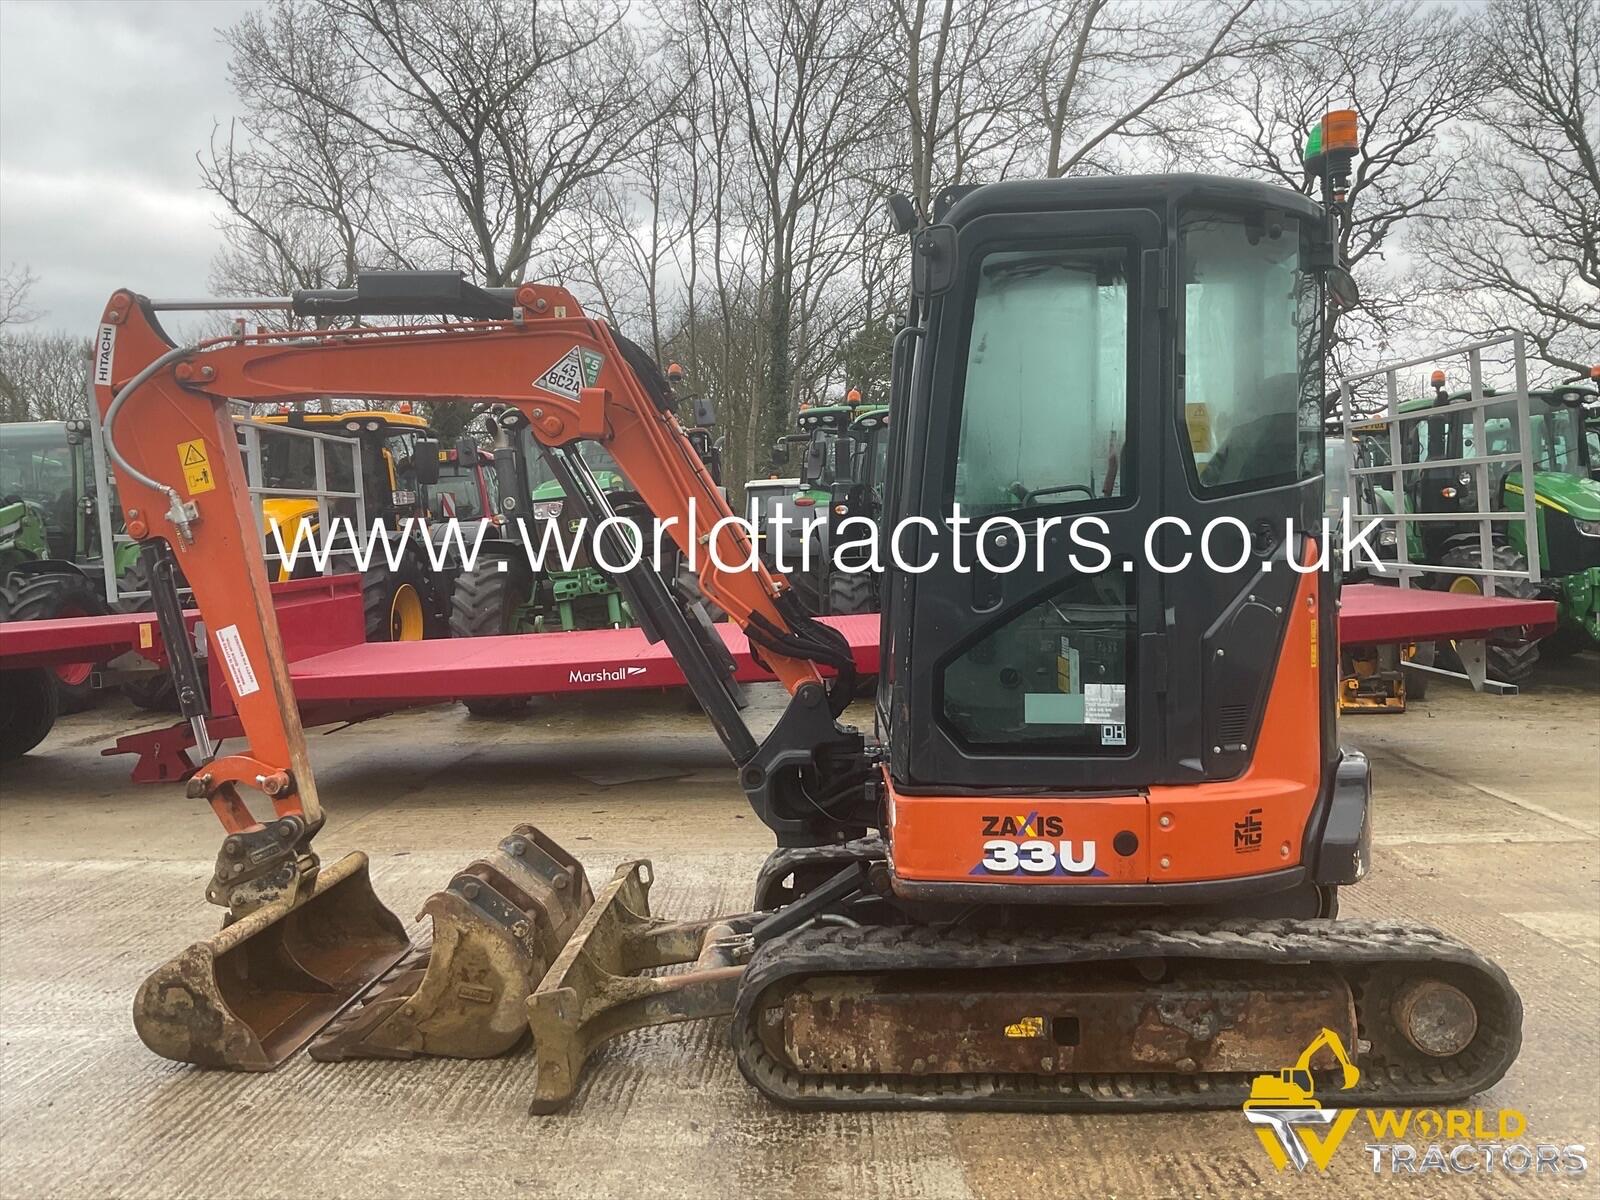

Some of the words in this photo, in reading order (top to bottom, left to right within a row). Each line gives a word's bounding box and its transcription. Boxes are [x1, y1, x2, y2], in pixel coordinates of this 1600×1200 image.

[99, 327, 112, 381] HITACHI
[548, 371, 580, 394] BC2A
[561, 363, 578, 378] 45
[569, 667, 626, 683] Marshall
[982, 811, 1063, 837] ZAXIS
[982, 840, 1096, 875] 33U
